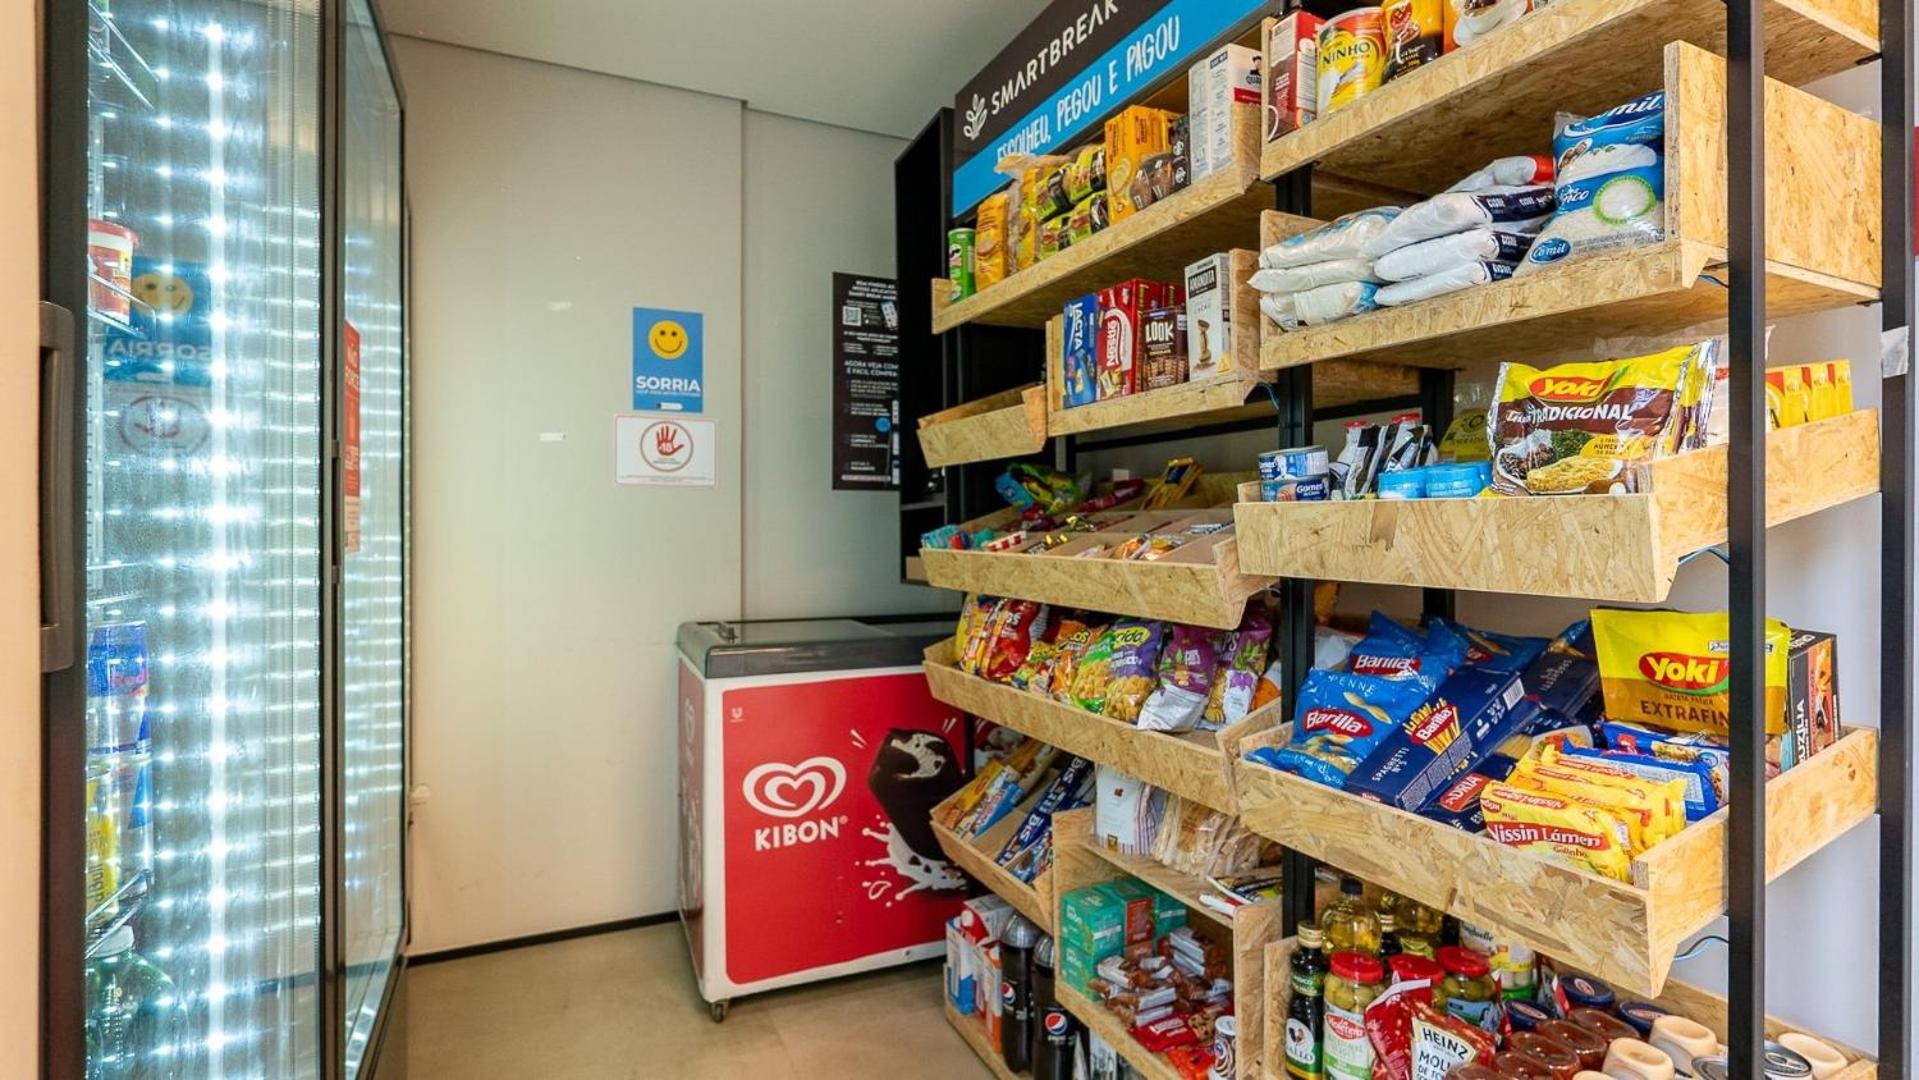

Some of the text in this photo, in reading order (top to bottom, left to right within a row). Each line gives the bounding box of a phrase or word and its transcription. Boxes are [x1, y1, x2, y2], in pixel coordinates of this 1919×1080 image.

[1322, 41, 1371, 67] NINHO
[1056, 73, 1102, 133] PEGOU
[1108, 59, 1119, 96] E
[1125, 15, 1181, 82] PAGOU
[1068, 301, 1083, 351] LACTA
[1145, 321, 1175, 343] LOOK
[635, 375, 701, 392] SORRIA
[1532, 403, 1634, 424] TRADICIONAL
[1354, 653, 1412, 671] Barilla
[1645, 656, 1719, 684] Yoki
[1306, 710, 1364, 735] Barilla
[1415, 706, 1452, 740] Barilla
[1639, 699, 1729, 729] EXTRAFIN
[1371, 746, 1410, 783] SPAGHETTI
[754, 816, 840, 851] KIBON
[1487, 823, 1539, 843] Nissin
[1541, 828, 1601, 847] Lámen
[1422, 1027, 1469, 1060] HEINZ
[1419, 1051, 1451, 1072] MOL
